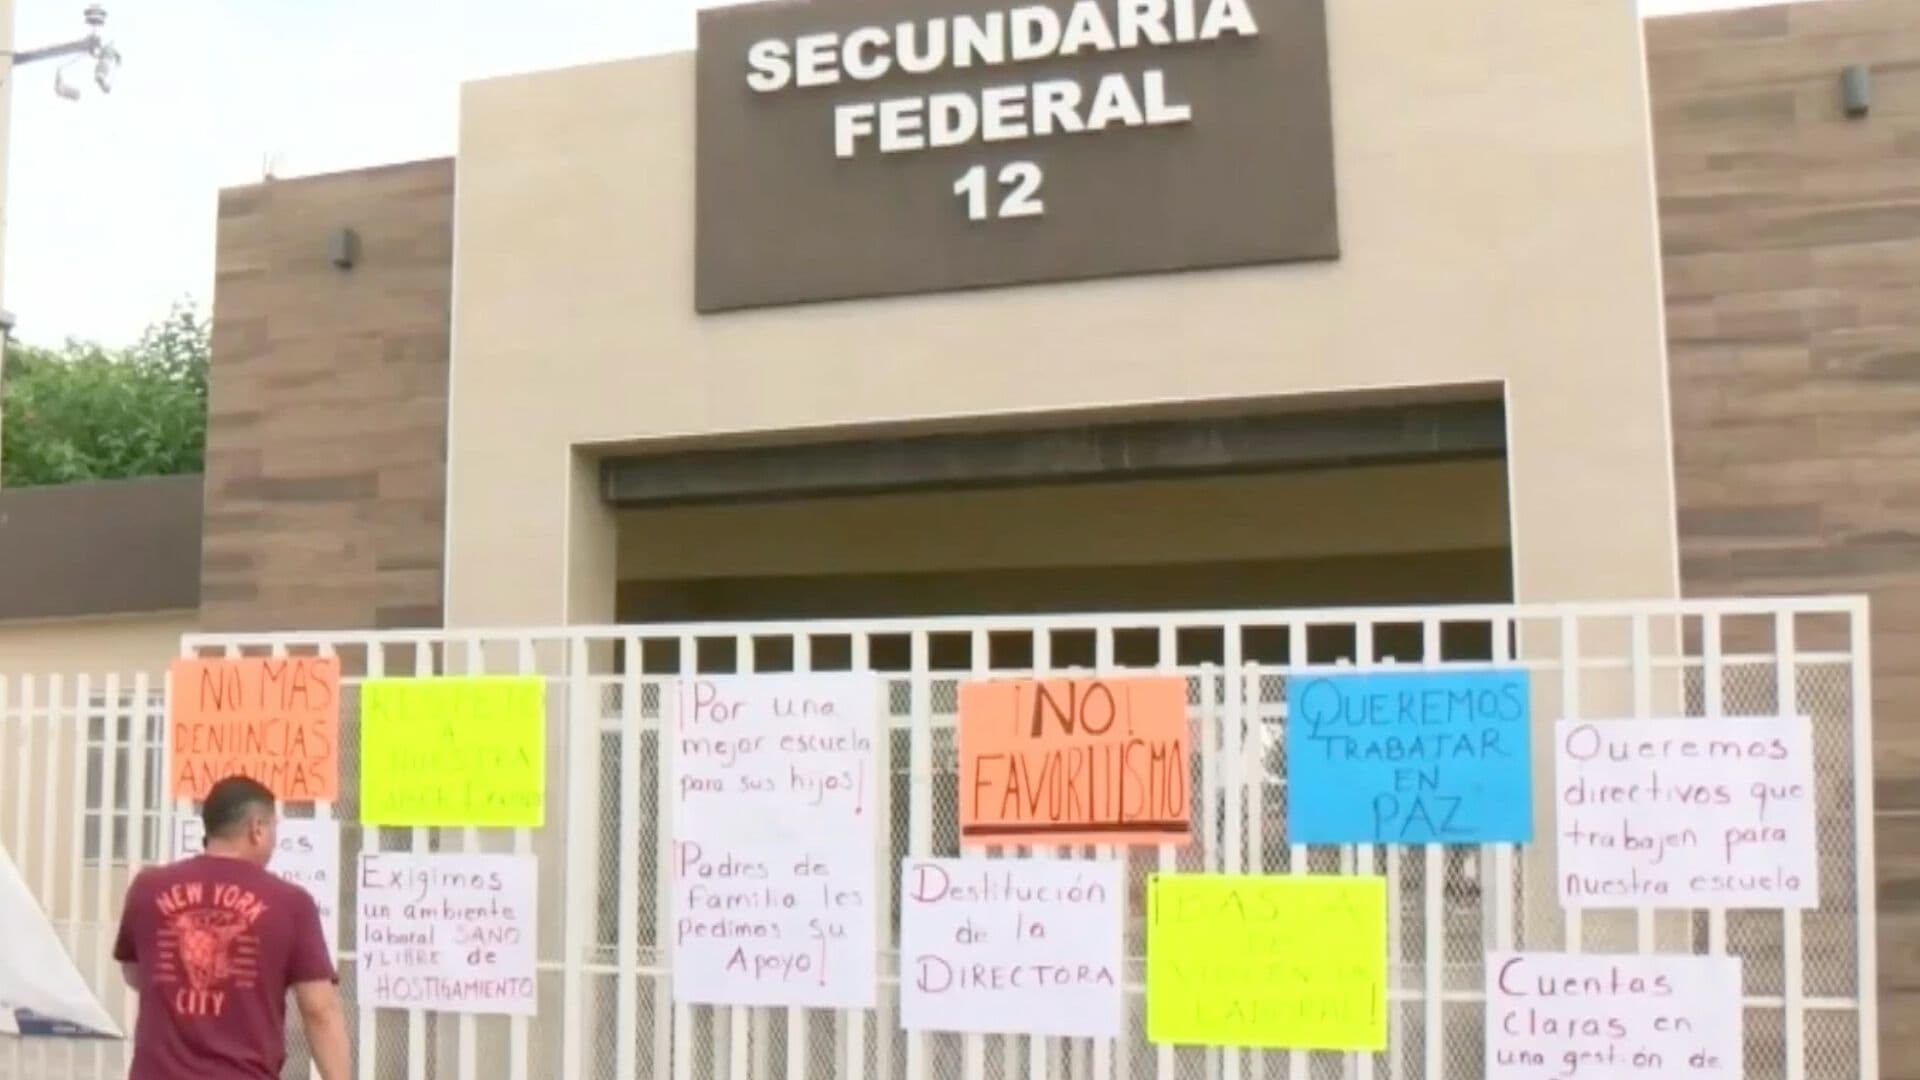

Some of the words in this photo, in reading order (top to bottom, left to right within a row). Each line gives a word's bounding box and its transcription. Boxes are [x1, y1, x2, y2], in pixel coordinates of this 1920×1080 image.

[745, 0, 1259, 93] SECUNDARIA
[833, 69, 1192, 159] FEDERAL
[953, 160, 1045, 221] 12
[200, 665, 243, 713] NO
[773, 697, 837, 718] una
[1300, 678, 1524, 741] QUEREMOS
[175, 718, 331, 760] DENUNCIAS
[681, 736, 767, 768] mejor
[779, 729, 872, 753] escuela
[680, 774, 724, 802] para
[739, 775, 777, 793] sus
[790, 758, 866, 815] hijos!
[1393, 766, 1441, 792] EN
[1563, 772, 1732, 807] directivos
[1749, 781, 1805, 821] que
[1373, 795, 1480, 839] PAZ
[1564, 821, 1697, 865] trabajen
[1725, 827, 1787, 864] para
[362, 854, 504, 903] Exigimos
[793, 854, 831, 878] de
[909, 862, 1107, 905] Destitución
[1566, 868, 1670, 896] nuestra
[1690, 867, 1801, 892] escuela
[155, 881, 204, 916] NEW
[212, 883, 269, 924] YORK
[364, 903, 391, 920] un
[403, 897, 517, 921] ambiente
[822, 884, 864, 909] les
[364, 923, 435, 945] laboral
[455, 924, 520, 946] SANO
[954, 920, 989, 945] de
[1015, 912, 1046, 938] la
[466, 949, 498, 967] de
[915, 955, 1115, 994] DIRECTORA
[1497, 956, 1674, 997] Cuentas
[175, 988, 226, 1017] CITY
[376, 973, 535, 1002] HOSTIGAMIENTO
[1653, 1015, 1693, 1033] en
[1496, 1048, 1545, 1067] una
[1688, 1046, 1722, 1069] de
